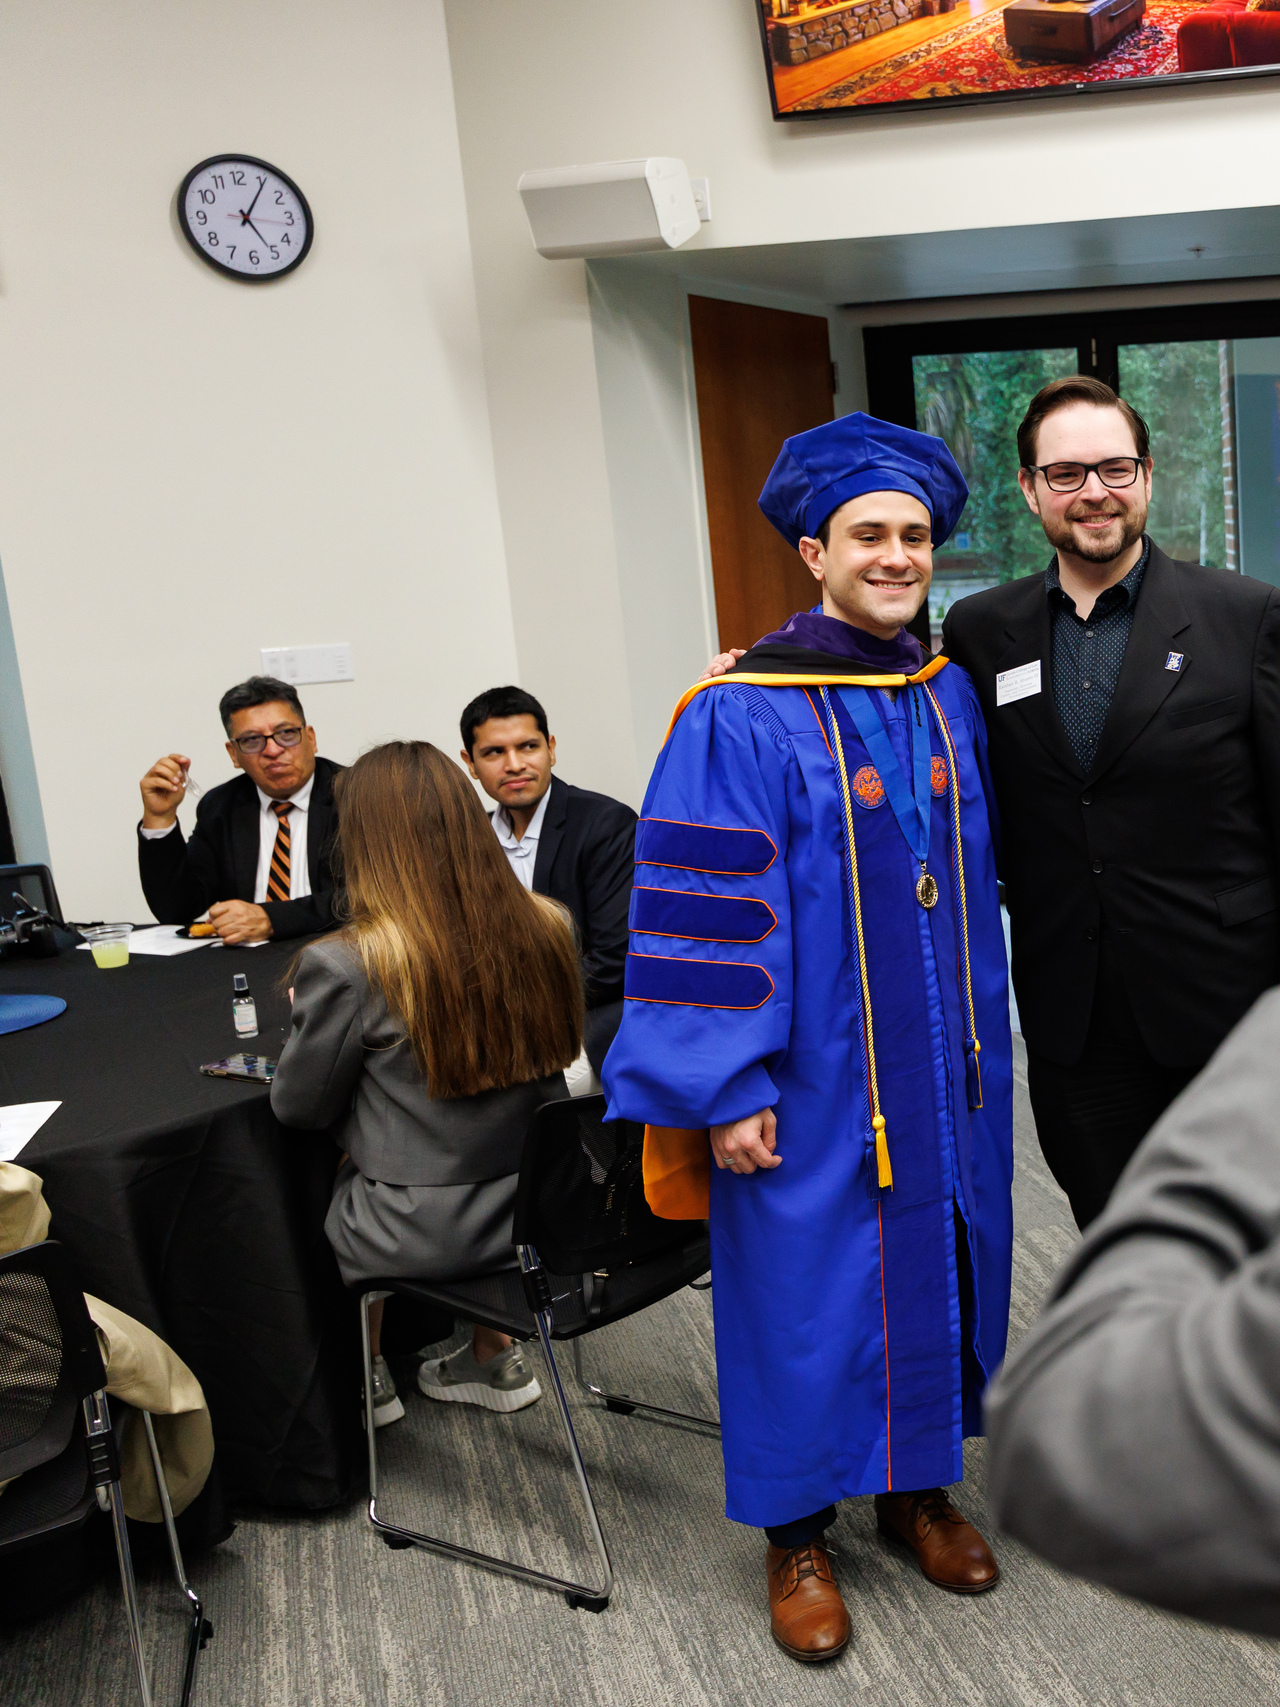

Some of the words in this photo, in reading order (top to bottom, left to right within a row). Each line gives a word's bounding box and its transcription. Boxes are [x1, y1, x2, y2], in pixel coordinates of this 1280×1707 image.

[211, 175, 225, 190] 11
[229, 170, 247, 186] 12
[197, 189, 216, 205] 10
[273, 190, 286, 205] 2
[195, 210, 208, 226] 9
[283, 211, 295, 226] 3
[207, 231, 220, 247] 8
[280, 232, 292, 247] 4
[226, 245, 237, 260] 7
[248, 250, 260, 266] 6
[269, 245, 280, 260] 5
